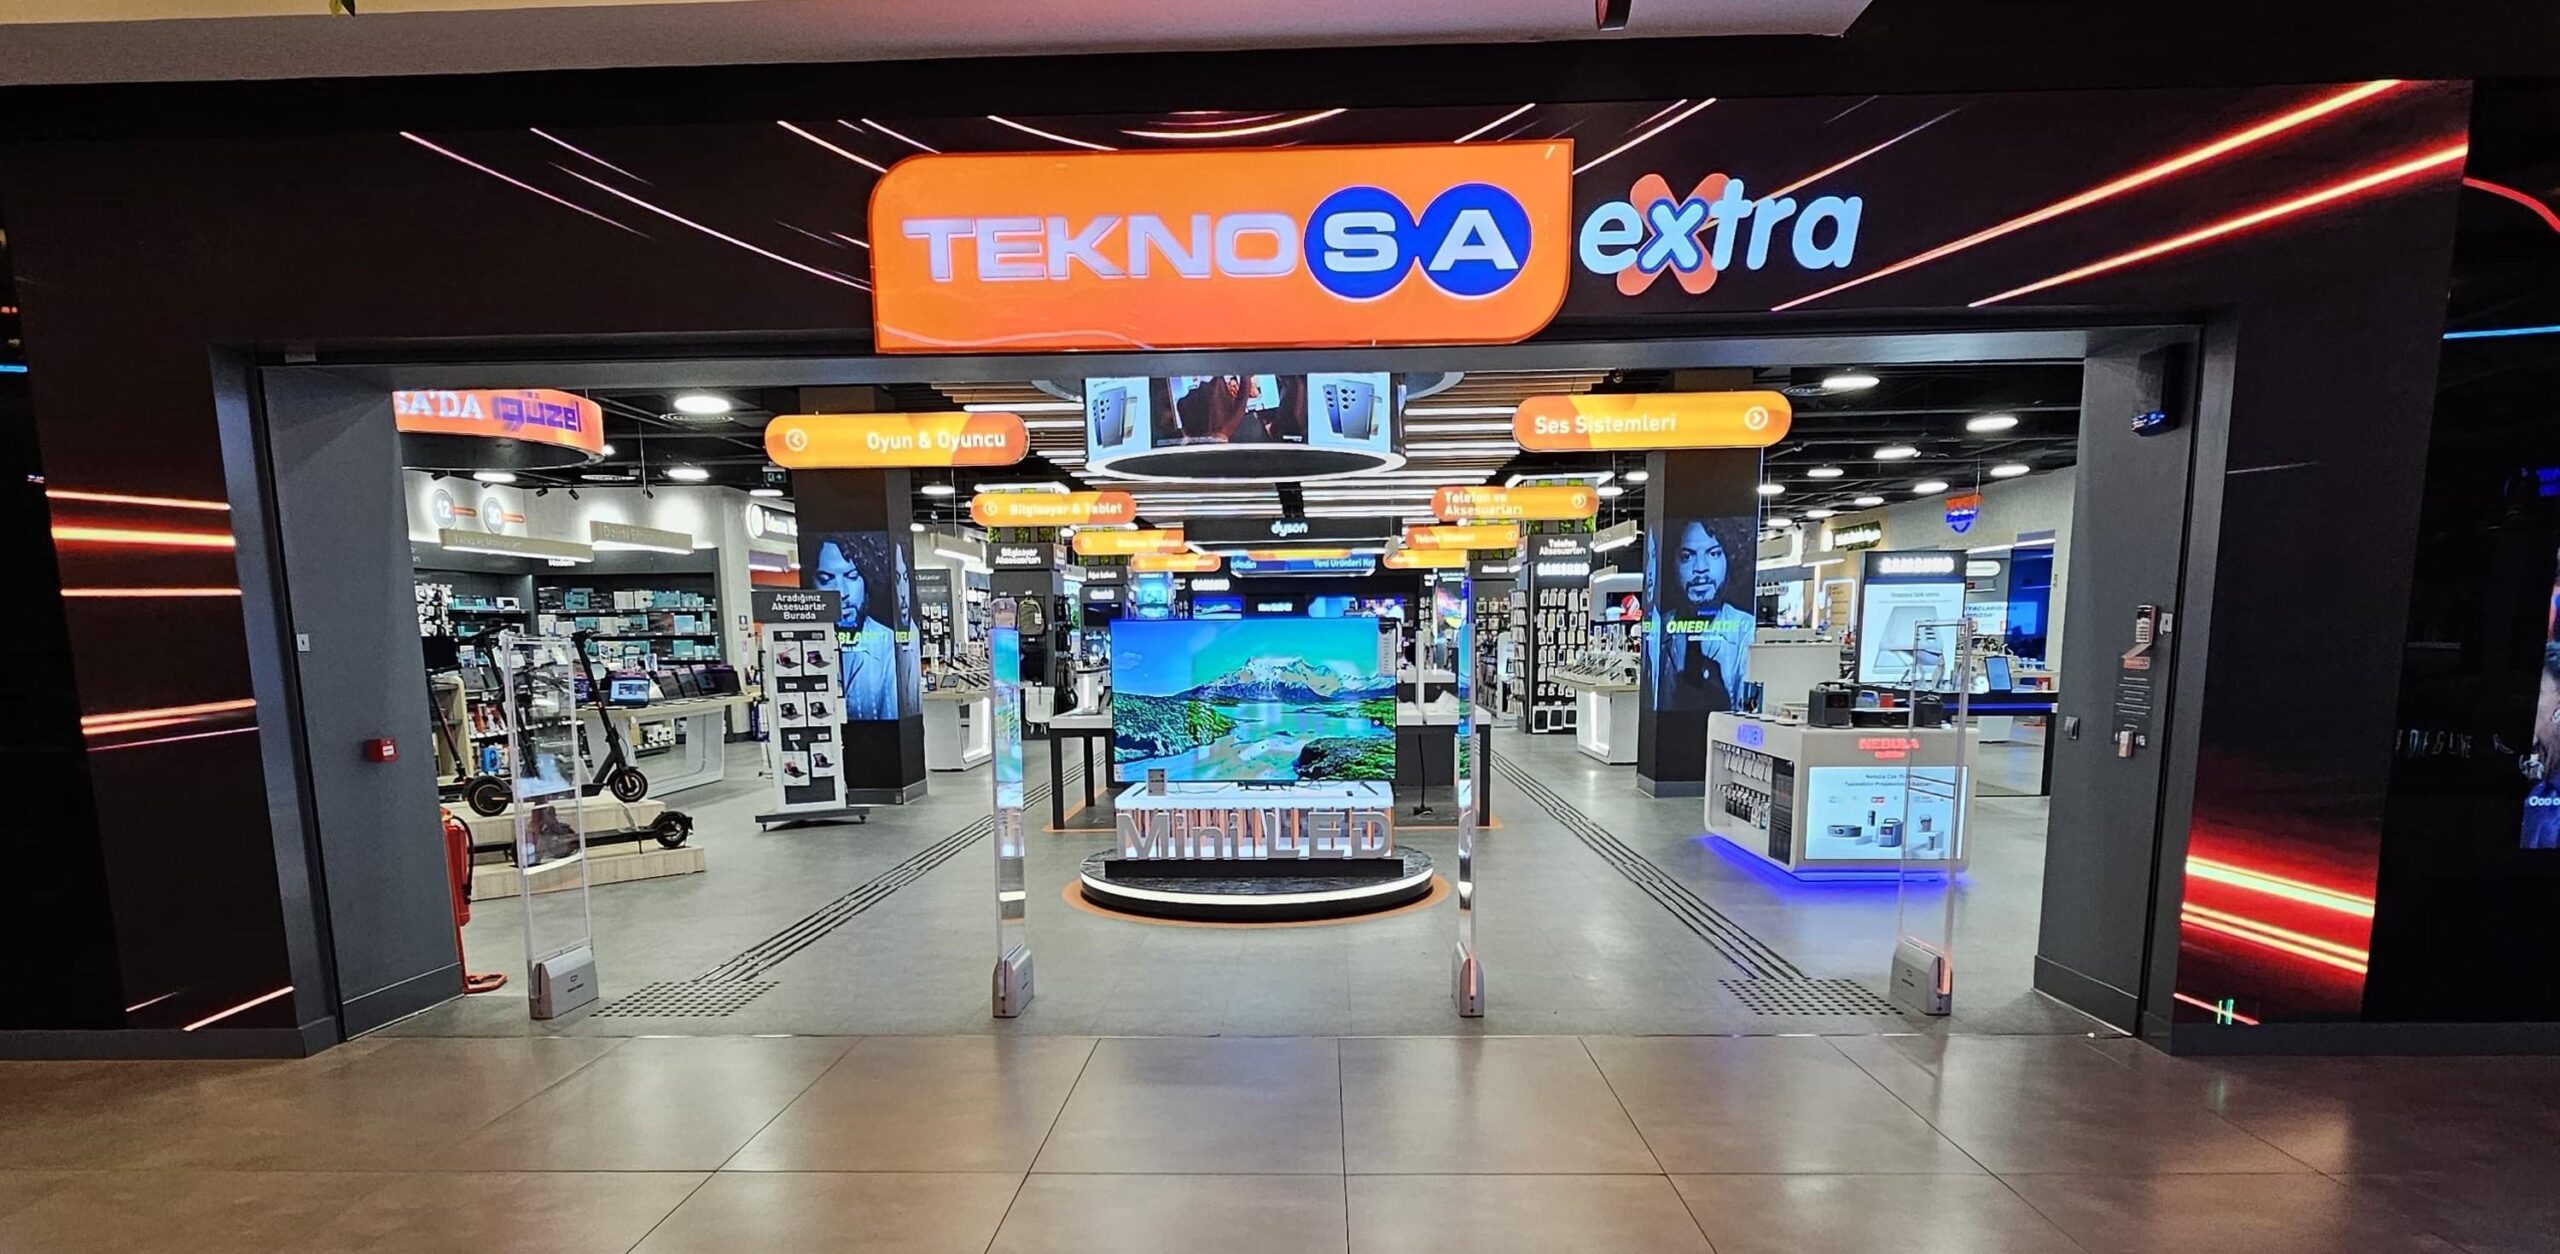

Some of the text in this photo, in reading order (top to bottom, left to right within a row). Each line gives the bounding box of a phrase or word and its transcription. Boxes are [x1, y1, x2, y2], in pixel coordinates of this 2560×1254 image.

[1579, 176, 1863, 276] extra
[902, 207, 1520, 282] TEKNOSA
[492, 391, 582, 432] güzel
[1534, 413, 1677, 434] Ses Sistemleri
[866, 431, 1007, 453] Oyun & Oyuncu
[1444, 492, 1490, 503] Telefon
[437, 501, 451, 518] 12
[1010, 503, 1122, 517] Bilgisayar & Tablet
[1444, 504, 1523, 516] Aksesuarları
[1271, 520, 1308, 537] dyson
[1313, 559, 1329, 567] Yeni
[1331, 558, 1361, 567] Ürünleri
[1537, 563, 1590, 576] SAMSUNG
[1878, 556, 1954, 574] SAMSUNG
[775, 594, 821, 603] Aradığınız
[771, 603, 826, 611] Aksesuarlar
[783, 611, 816, 620] Burada
[1858, 738, 1920, 749] NEBULA
[1116, 812, 1393, 860] Mini LED
